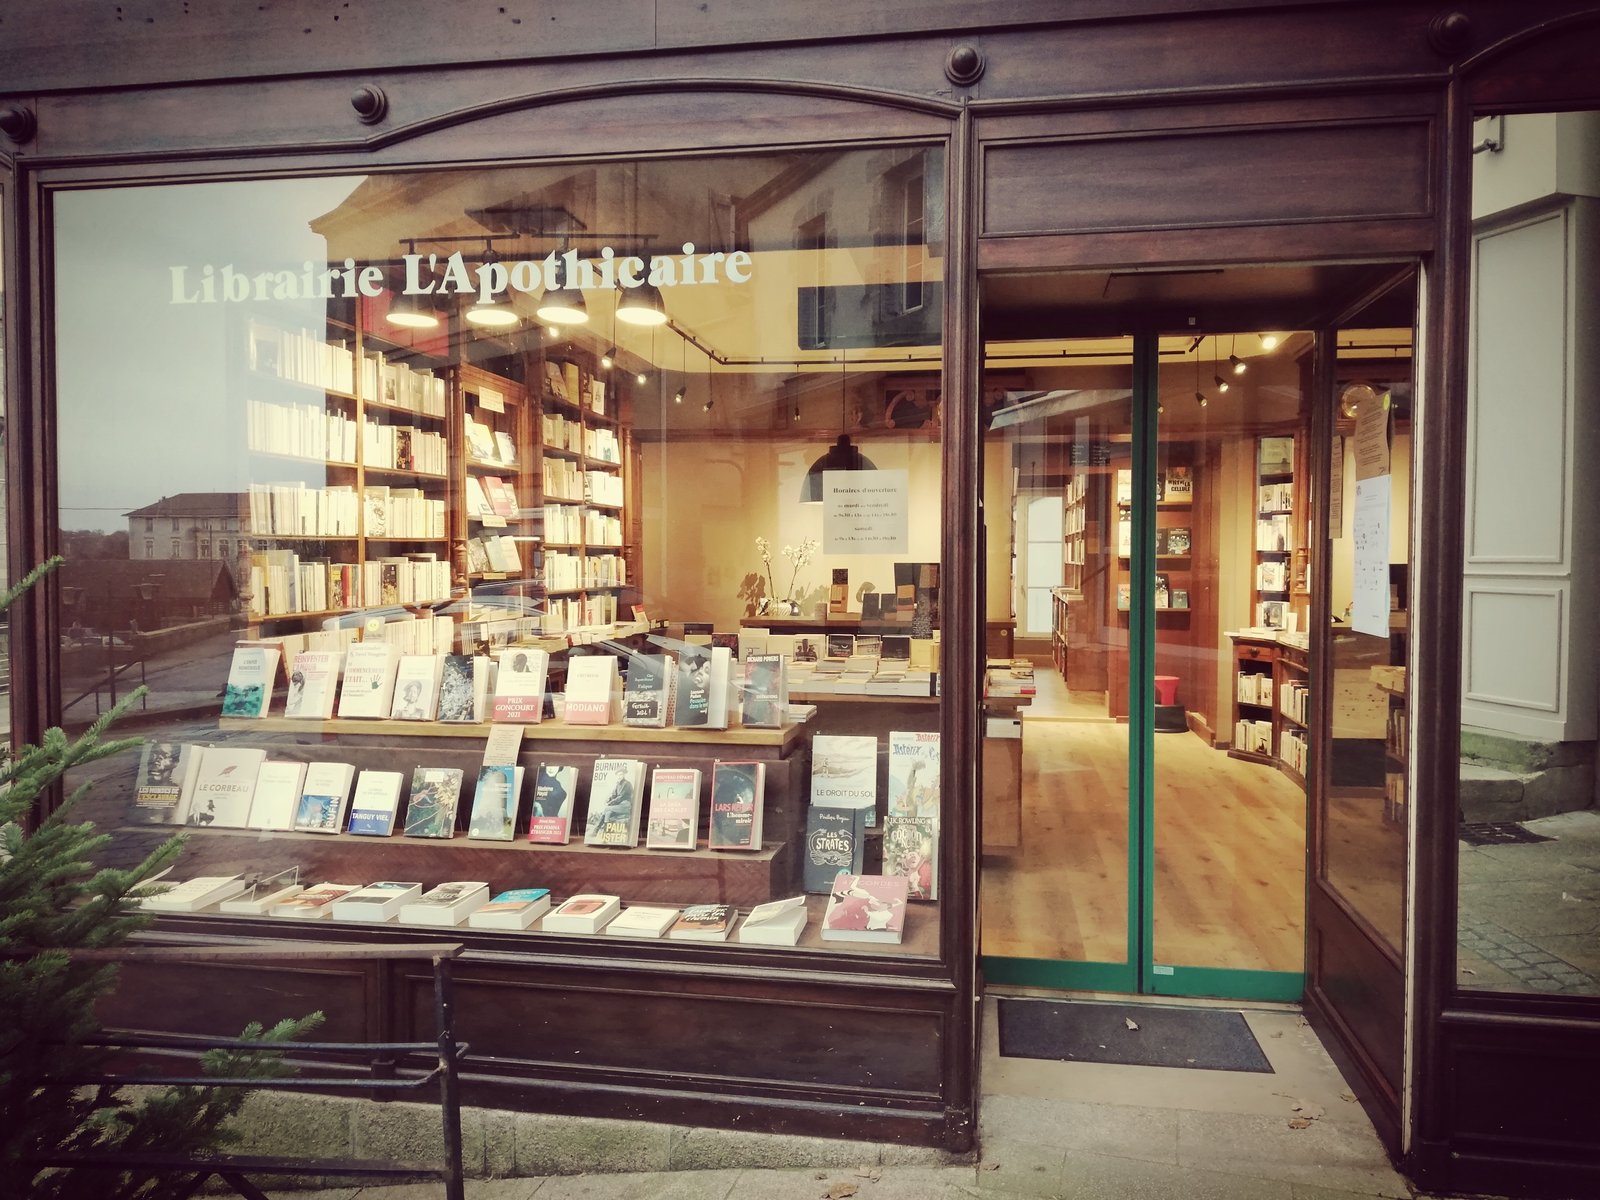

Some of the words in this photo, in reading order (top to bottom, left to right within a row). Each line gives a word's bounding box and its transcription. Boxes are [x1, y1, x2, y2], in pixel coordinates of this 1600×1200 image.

[169, 258, 384, 304] Librairie
[402, 242, 752, 304] L'Apothicaire
[566, 703, 605, 712] MODIANO
[595, 762, 627, 772] BURNING
[593, 772, 608, 781] BOY
[210, 784, 249, 793] CORBEAU
[715, 803, 731, 812] LARS
[325, 797, 340, 828] RUFIN
[352, 812, 375, 820] TANGUY
[376, 813, 389, 821] VIEL
[606, 822, 628, 833] PAUL
[816, 837, 850, 851] STRATES
